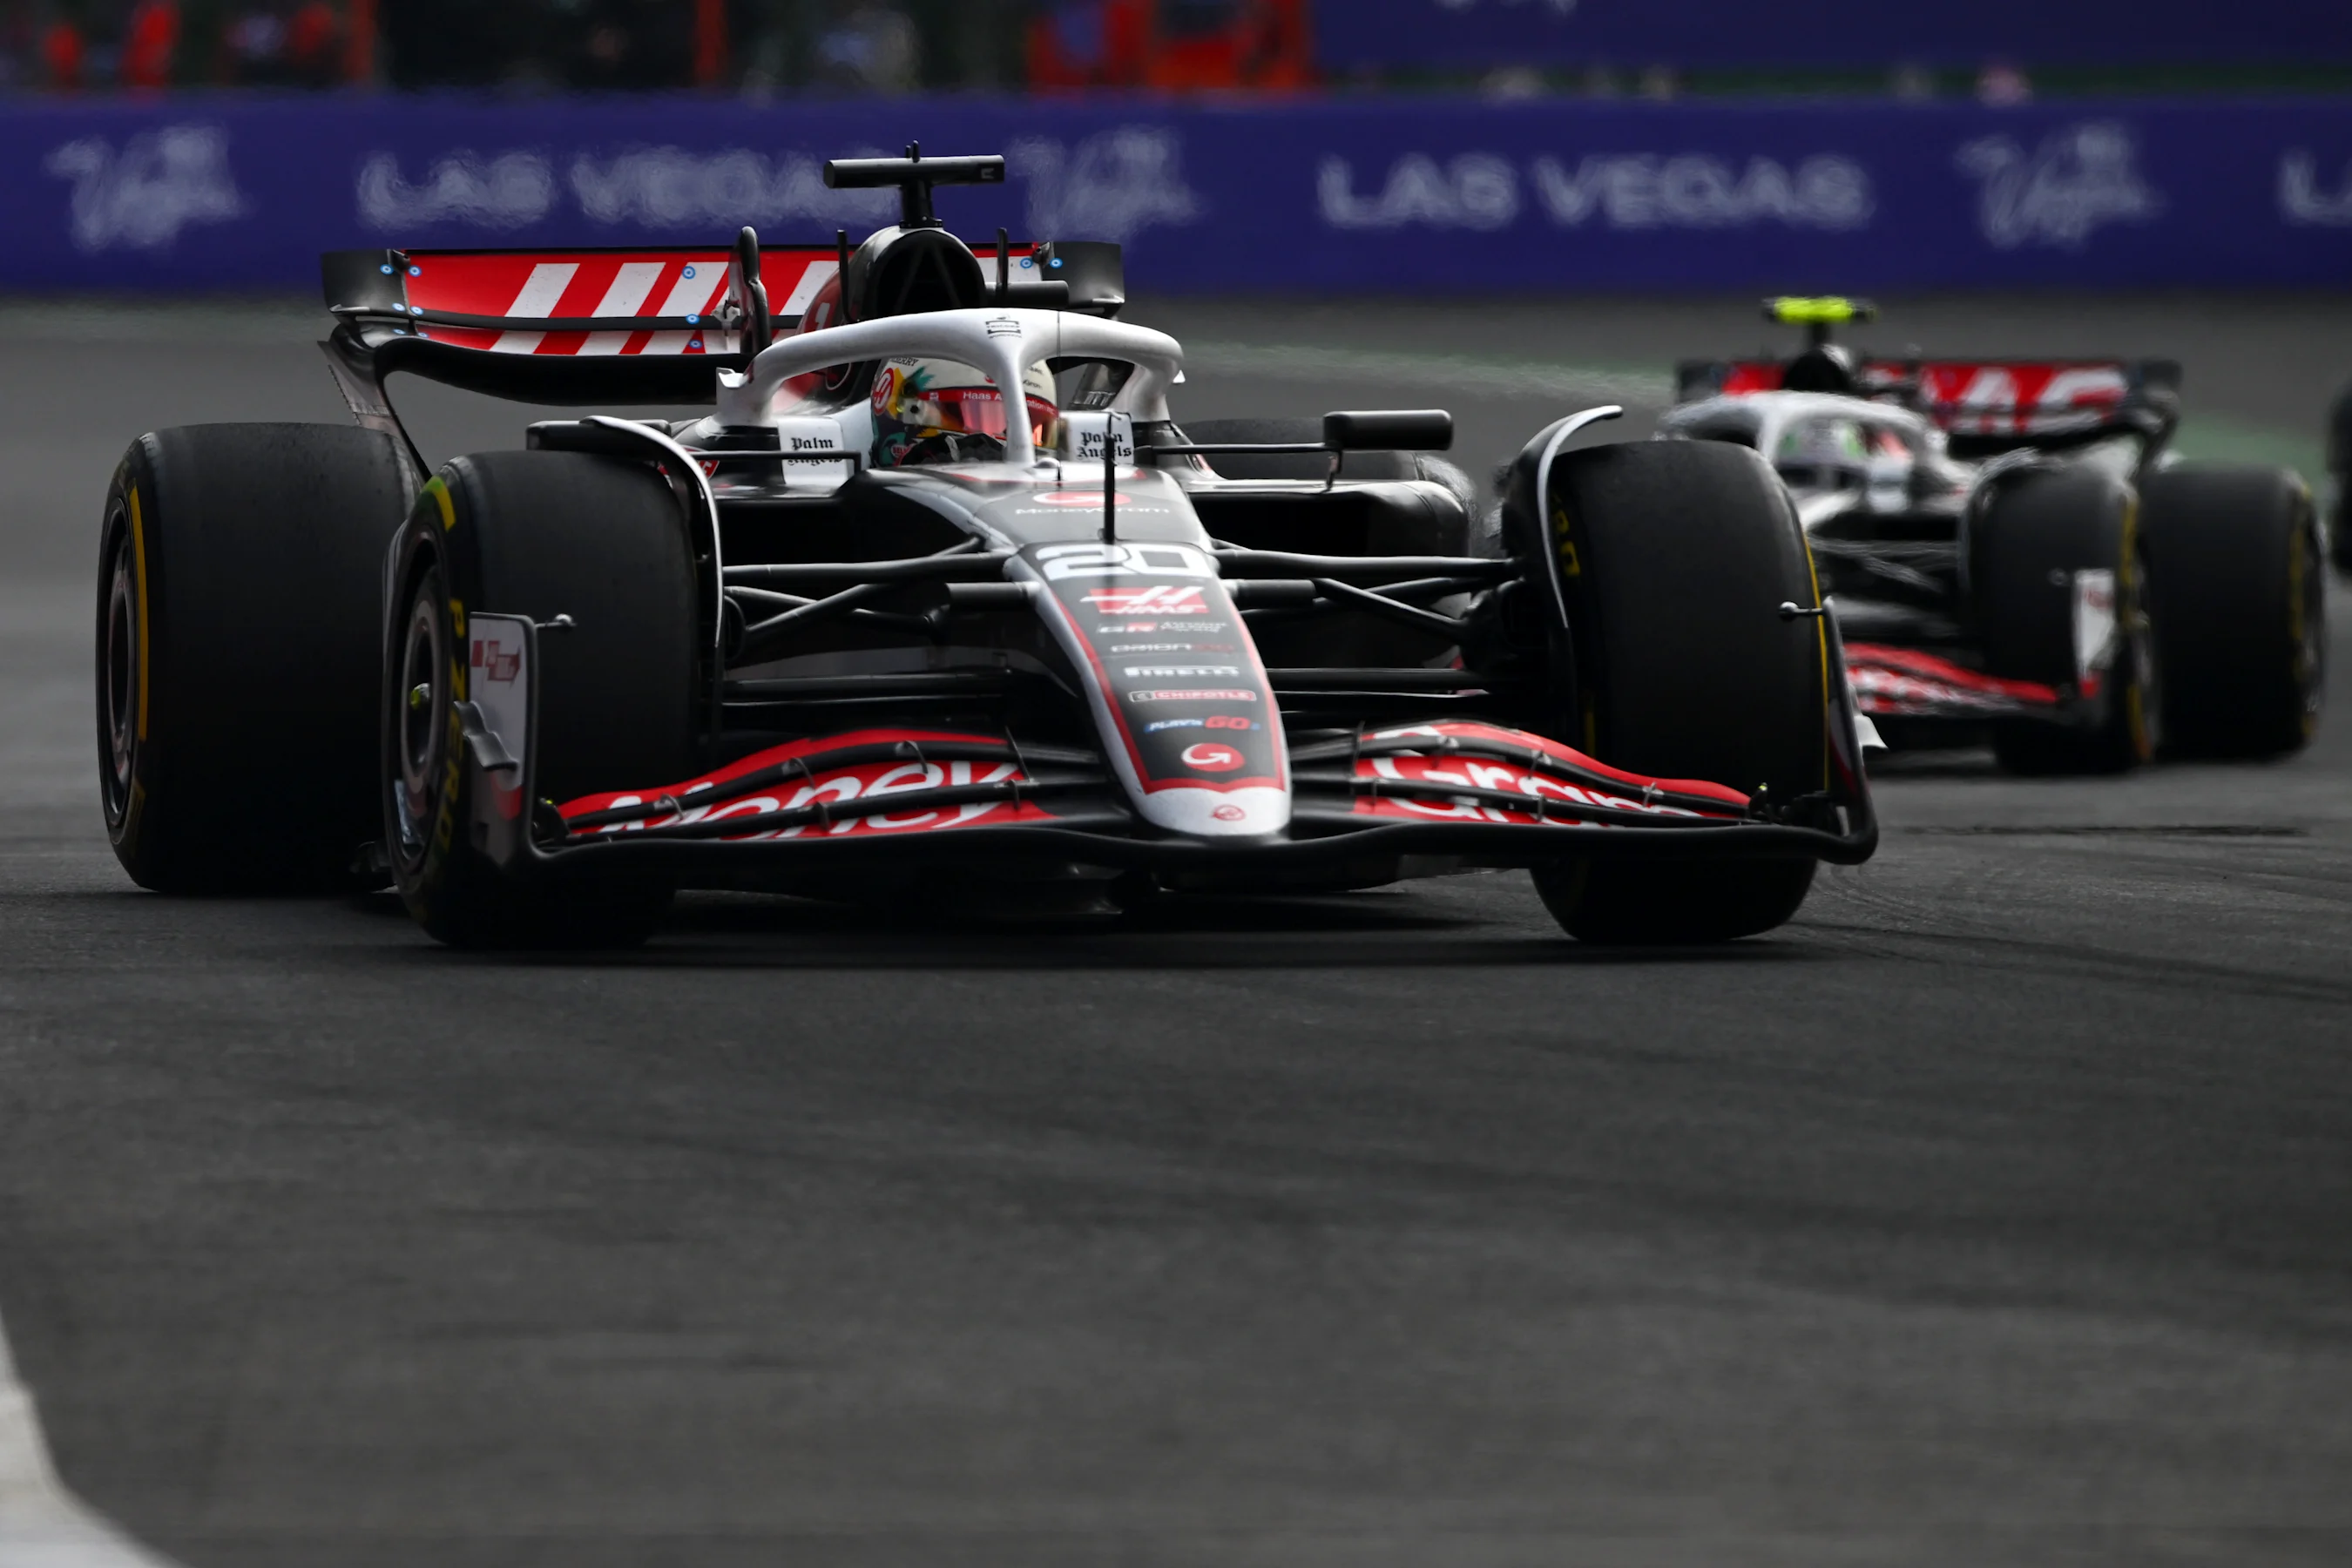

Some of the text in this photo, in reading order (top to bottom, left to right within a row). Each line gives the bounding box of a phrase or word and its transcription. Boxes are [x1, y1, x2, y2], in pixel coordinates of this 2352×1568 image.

[1318, 153, 1519, 230] LAS
[1530, 153, 1873, 230] VEGAS
[963, 391, 991, 401] Haas
[791, 437, 834, 450] Palm
[1035, 544, 1213, 581] 20
[1124, 666, 1239, 676] PIRELLI
